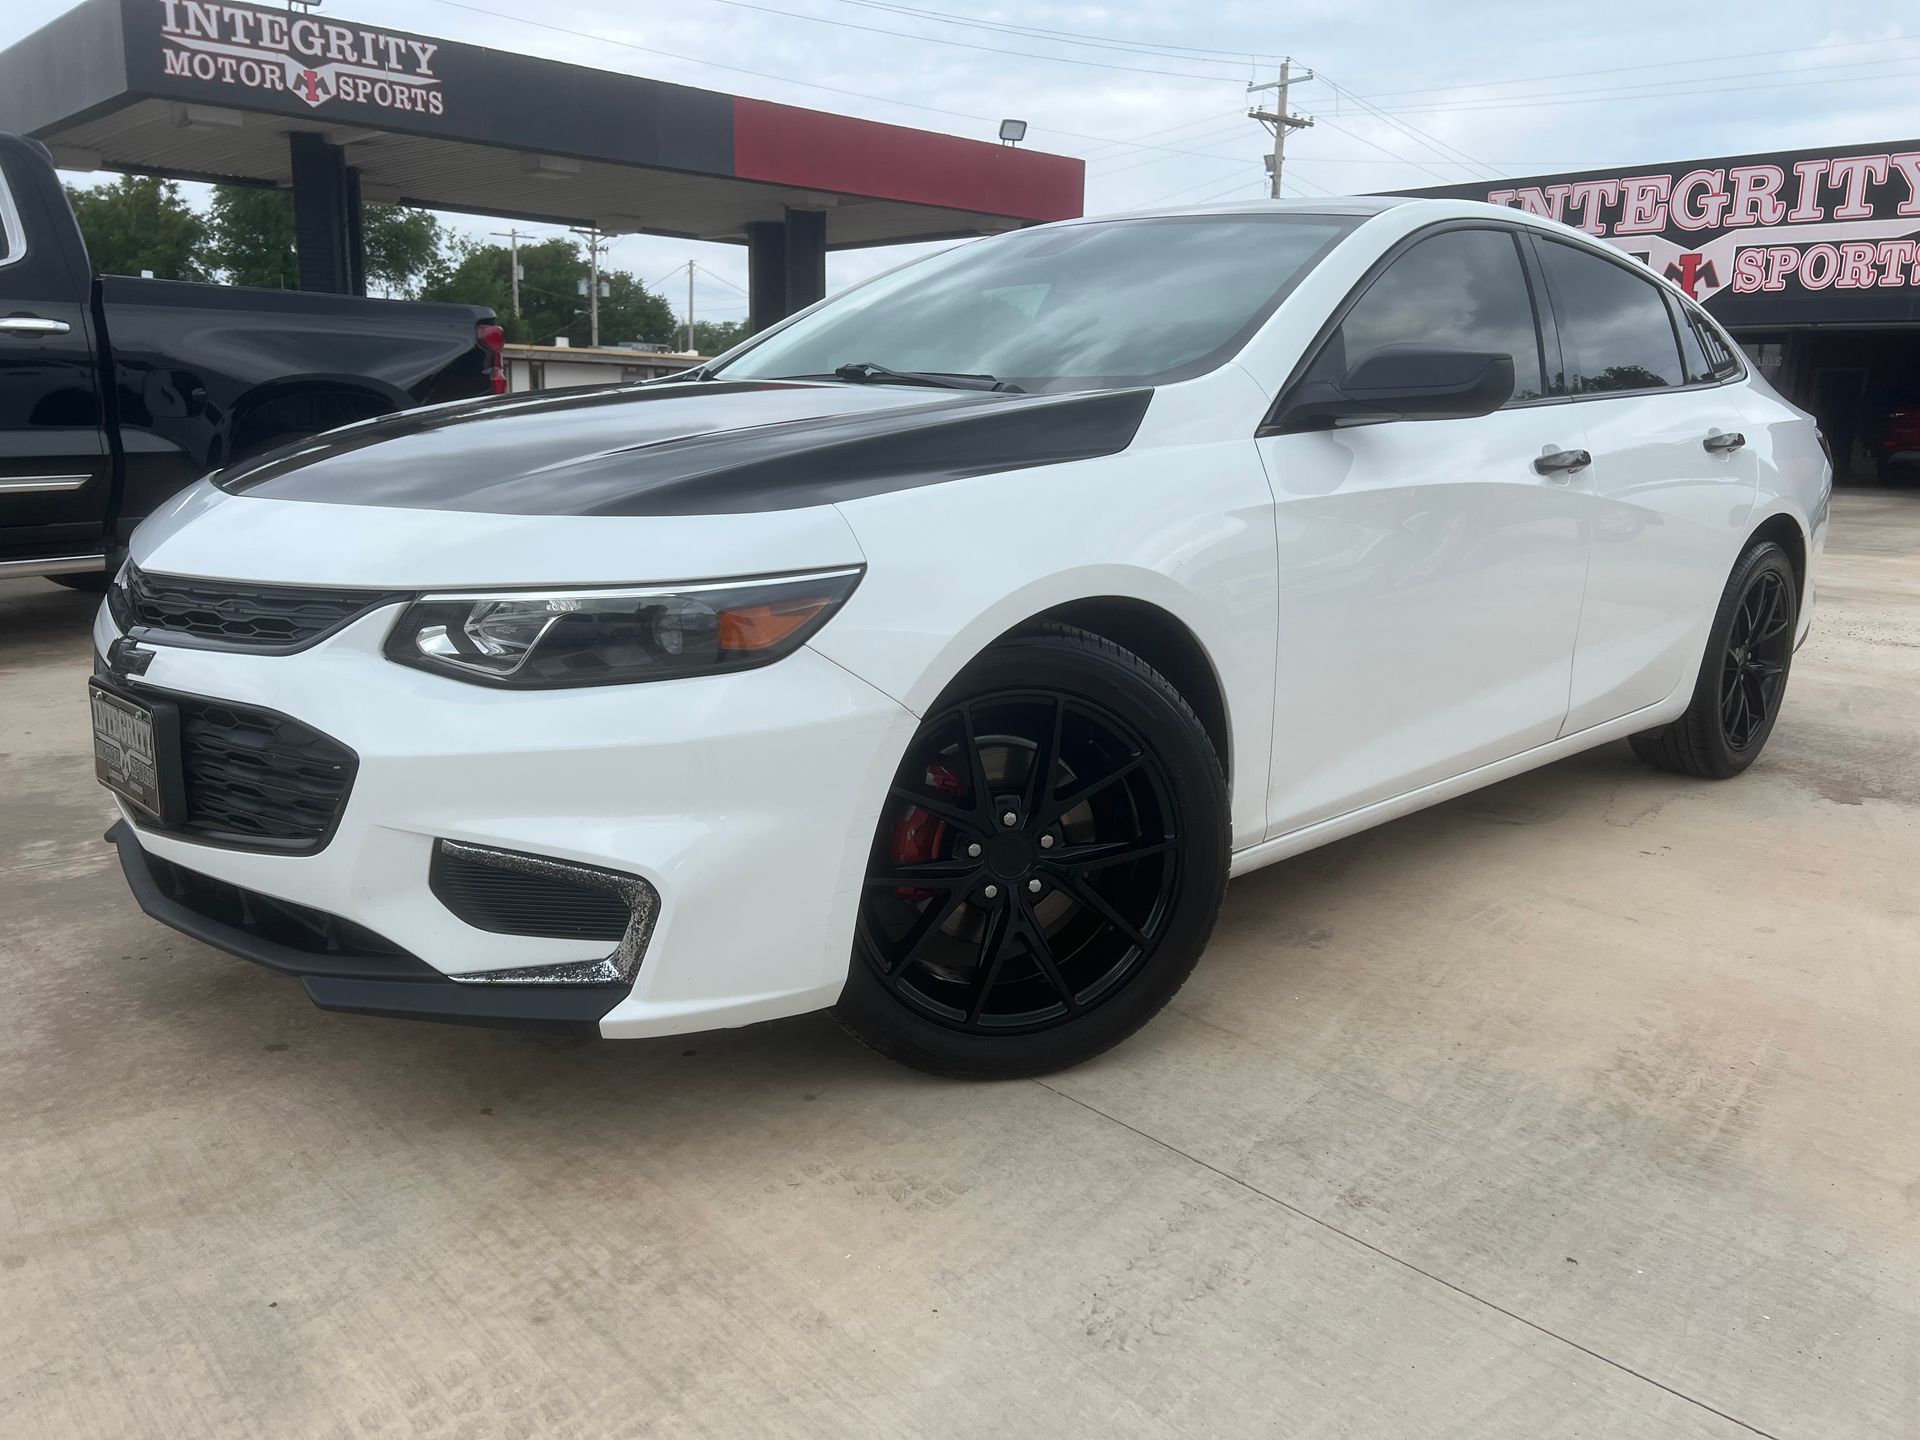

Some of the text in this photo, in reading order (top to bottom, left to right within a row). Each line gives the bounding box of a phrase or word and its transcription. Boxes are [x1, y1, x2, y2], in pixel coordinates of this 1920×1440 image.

[161, 0, 438, 75] INTEGRITY
[162, 49, 444, 115] MOTOR SPORTS
[1487, 152, 1920, 236] NTEGRIT
[1733, 240, 1920, 292] SPORT
[92, 698, 153, 760] INTEGRITY
